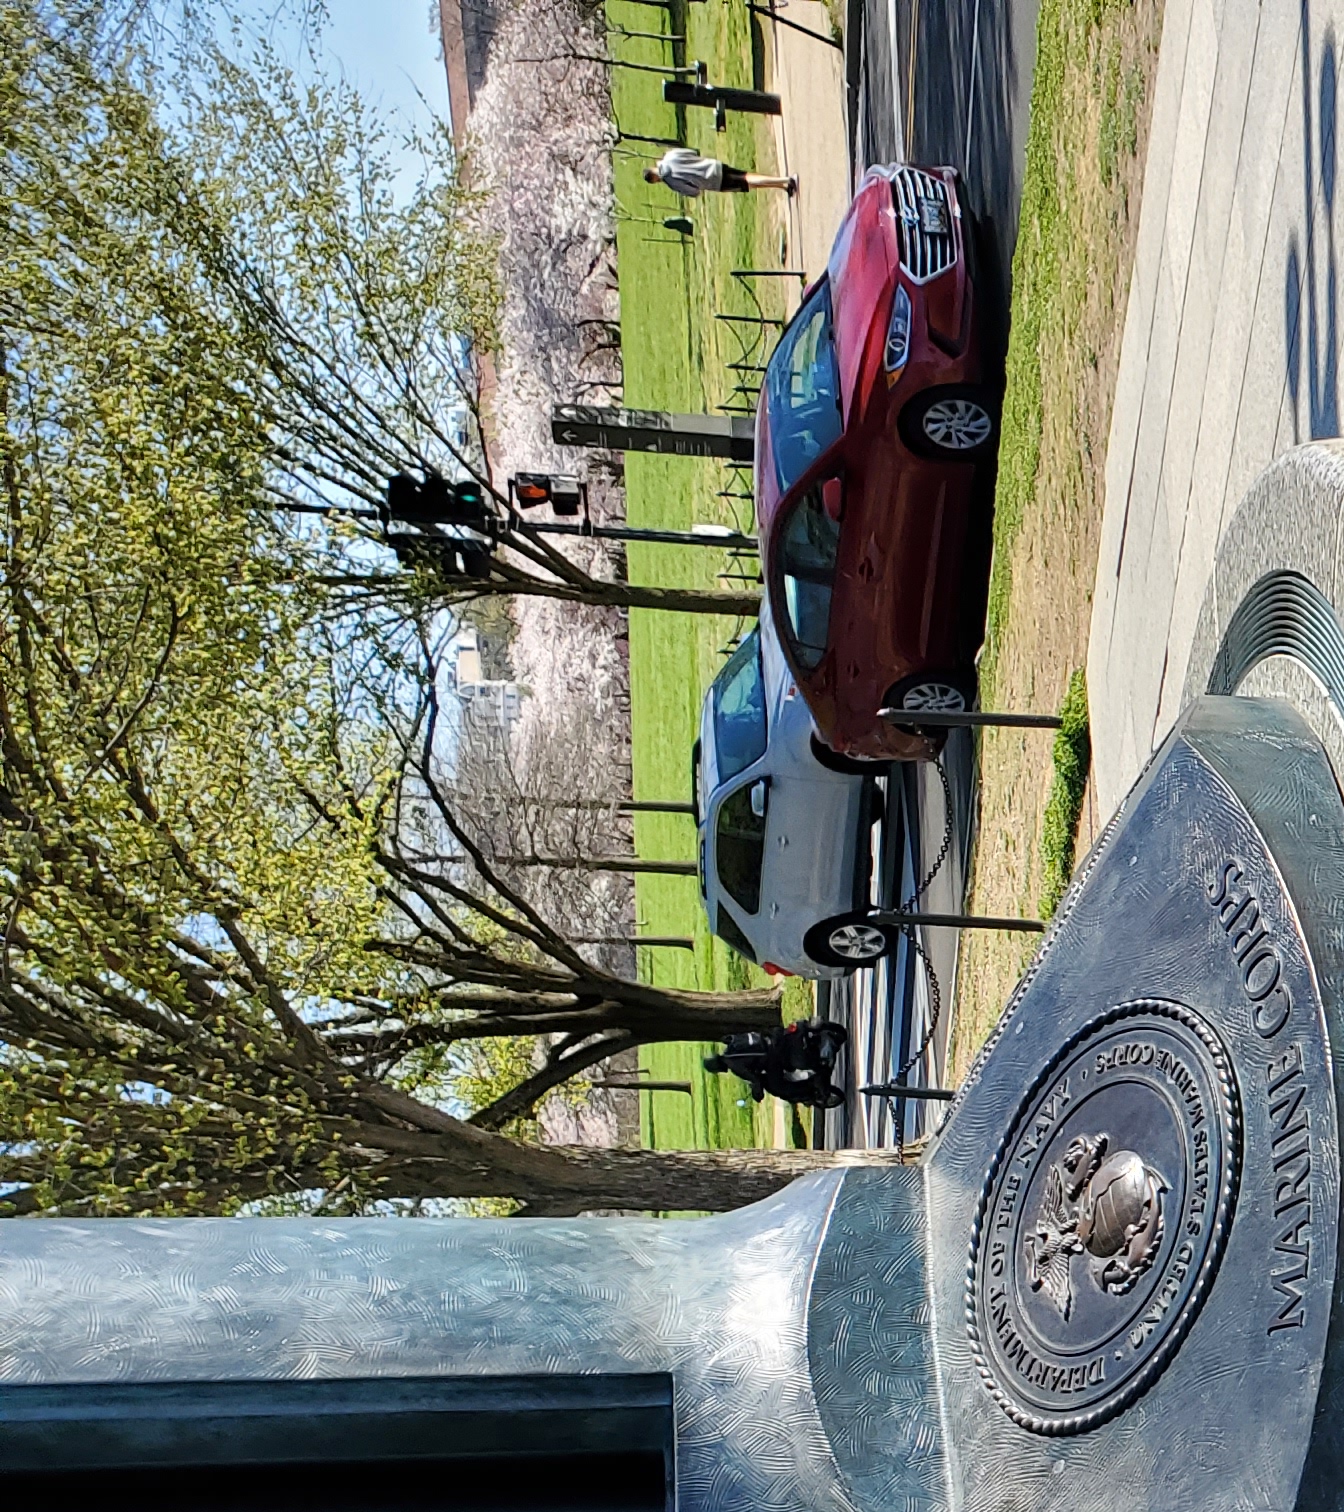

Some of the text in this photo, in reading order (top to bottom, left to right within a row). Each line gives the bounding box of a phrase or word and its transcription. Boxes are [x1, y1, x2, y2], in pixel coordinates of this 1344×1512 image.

[989, 1076, 1105, 1393] DEPARTMENT OF THE NAVY
[1094, 1041, 1210, 1350] UNITED STATES MARINE CORPS
[1206, 858, 1312, 1336] MARINE CORPS
